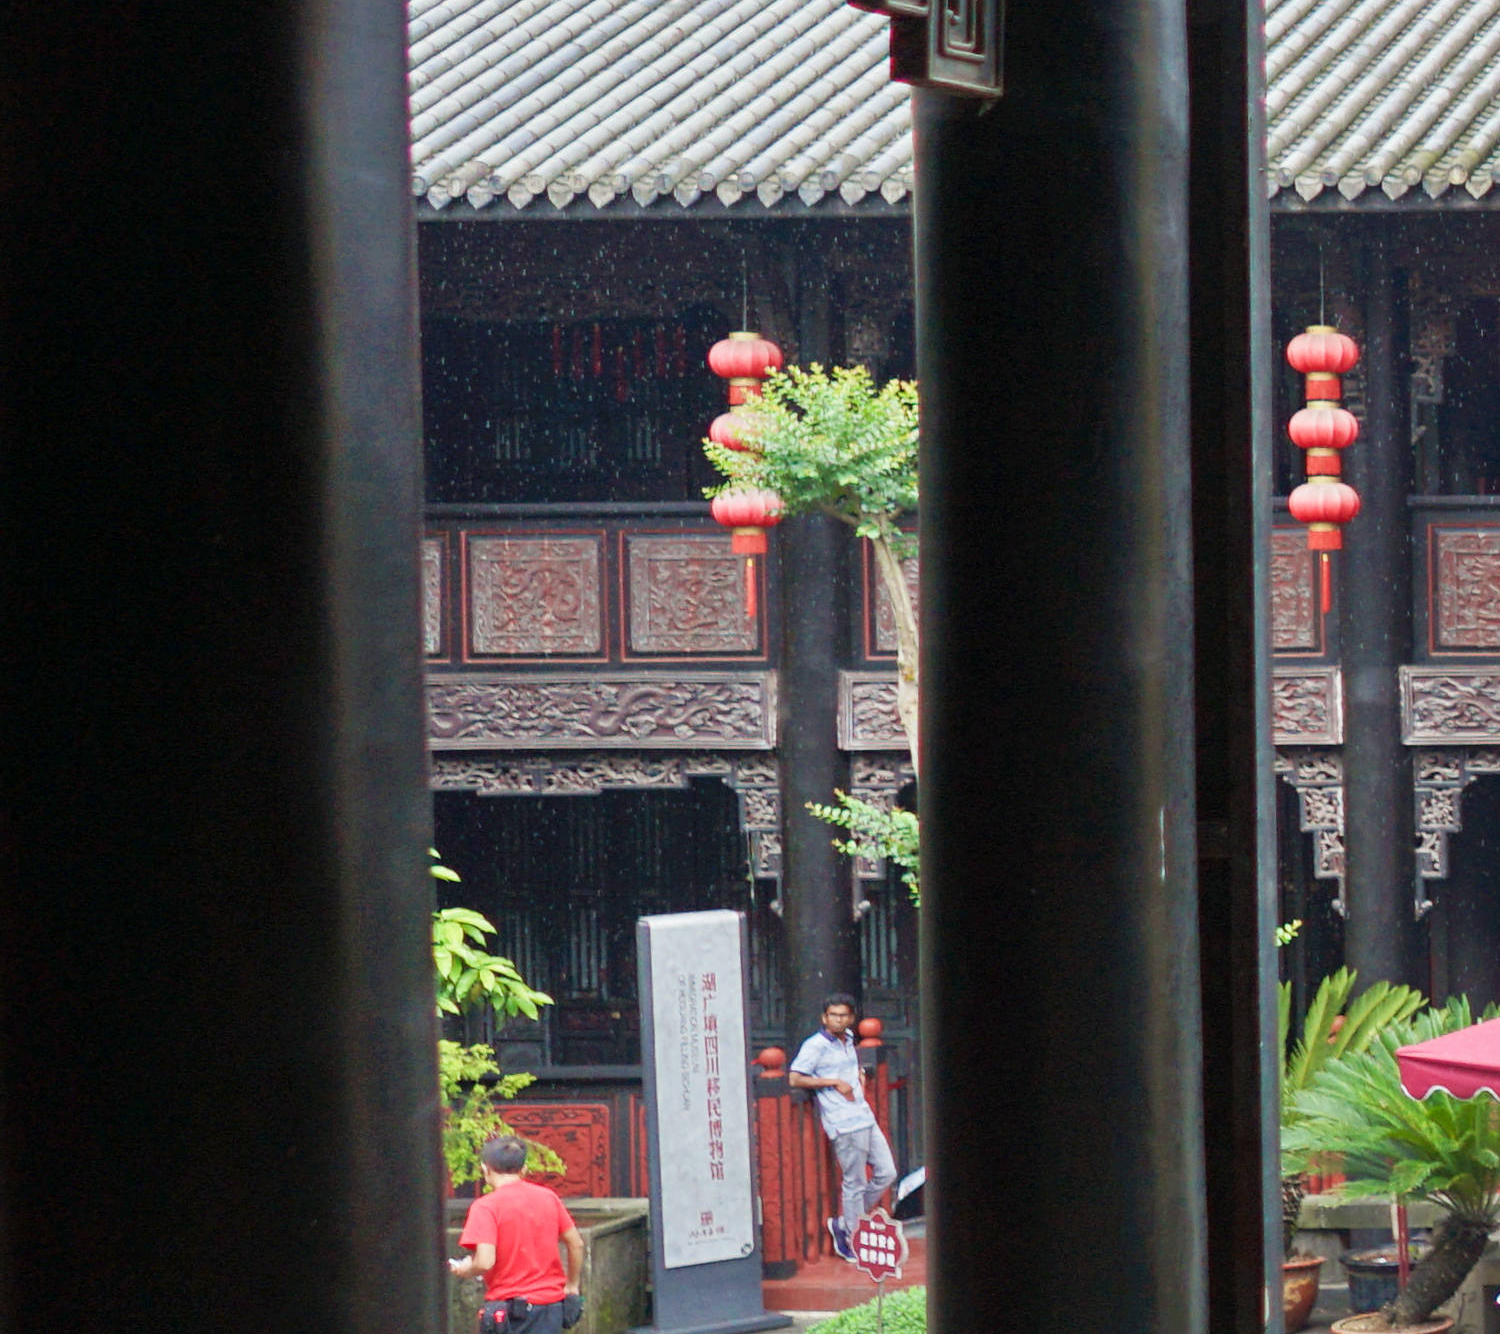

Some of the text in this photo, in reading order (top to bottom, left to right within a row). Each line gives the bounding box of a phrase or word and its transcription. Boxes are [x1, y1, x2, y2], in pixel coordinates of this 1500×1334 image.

[701, 971, 724, 1180] 湖广填四川移民博物馆
